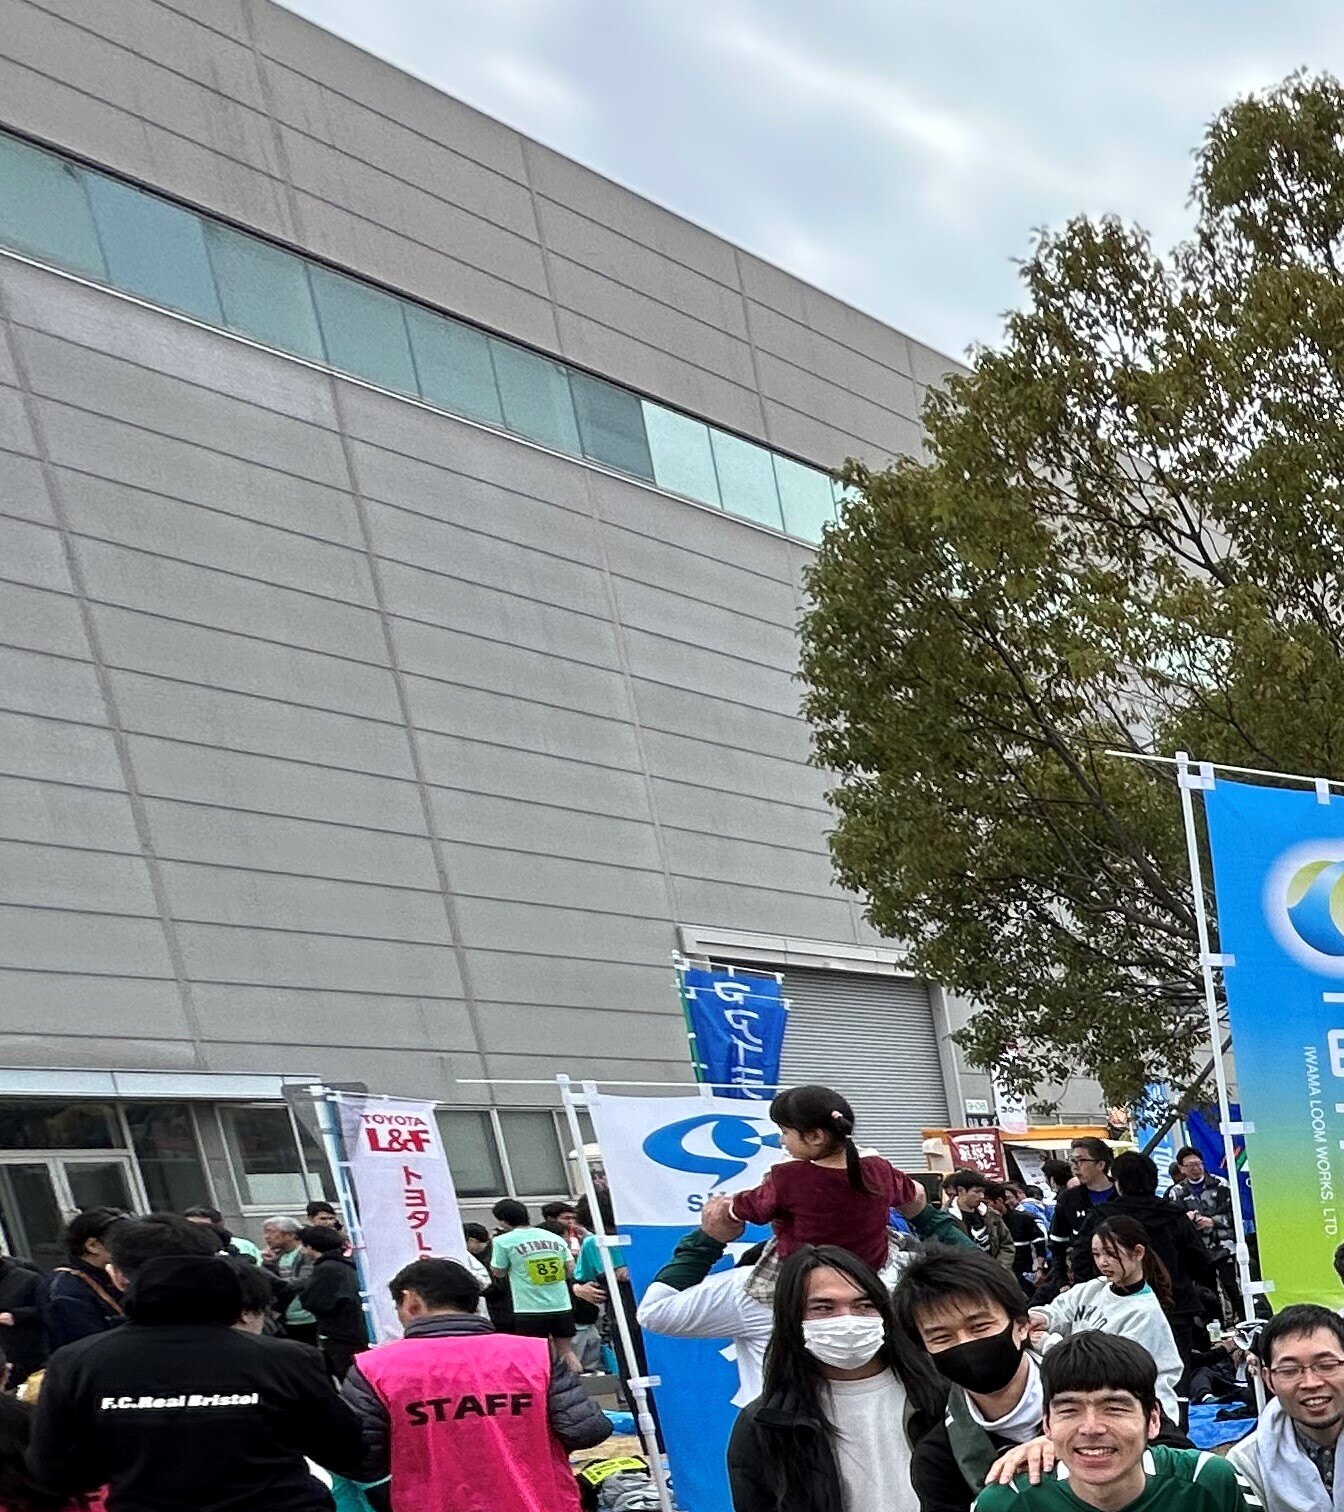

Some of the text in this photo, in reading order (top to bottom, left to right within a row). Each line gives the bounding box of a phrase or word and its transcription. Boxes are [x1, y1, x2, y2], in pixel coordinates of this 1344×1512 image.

[1303, 1045, 1322, 1097] IWAMA
[360, 1113, 428, 1128] TOYOTA
[365, 1127, 432, 1153] L&F
[1309, 1100, 1328, 1144] LOOM
[1315, 1146, 1335, 1204] WORKS,
[402, 1165, 433, 1260] トヨタL
[536, 1261, 560, 1276] 85
[404, 1391, 534, 1426] STAFF
